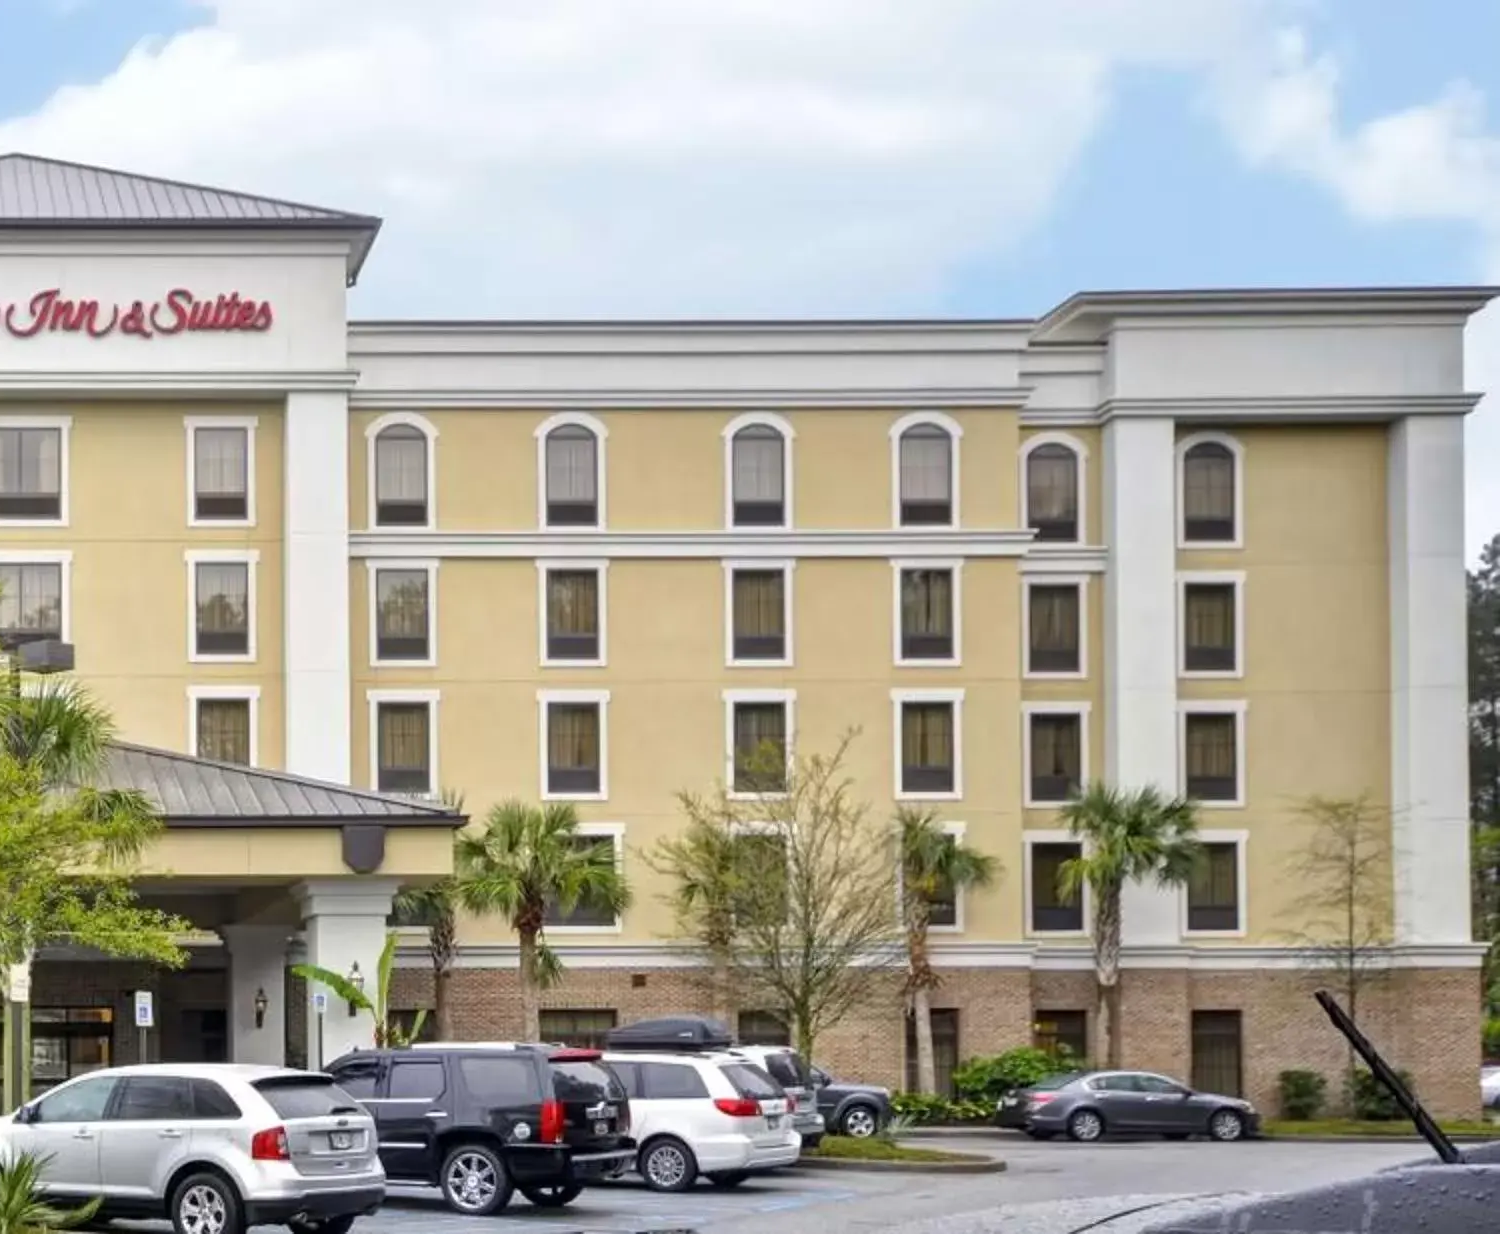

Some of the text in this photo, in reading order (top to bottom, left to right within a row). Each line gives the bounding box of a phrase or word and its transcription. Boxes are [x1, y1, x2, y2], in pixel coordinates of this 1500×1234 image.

[6, 288, 118, 338] Inn
[120, 300, 152, 339] &
[150, 289, 273, 334] Suites
